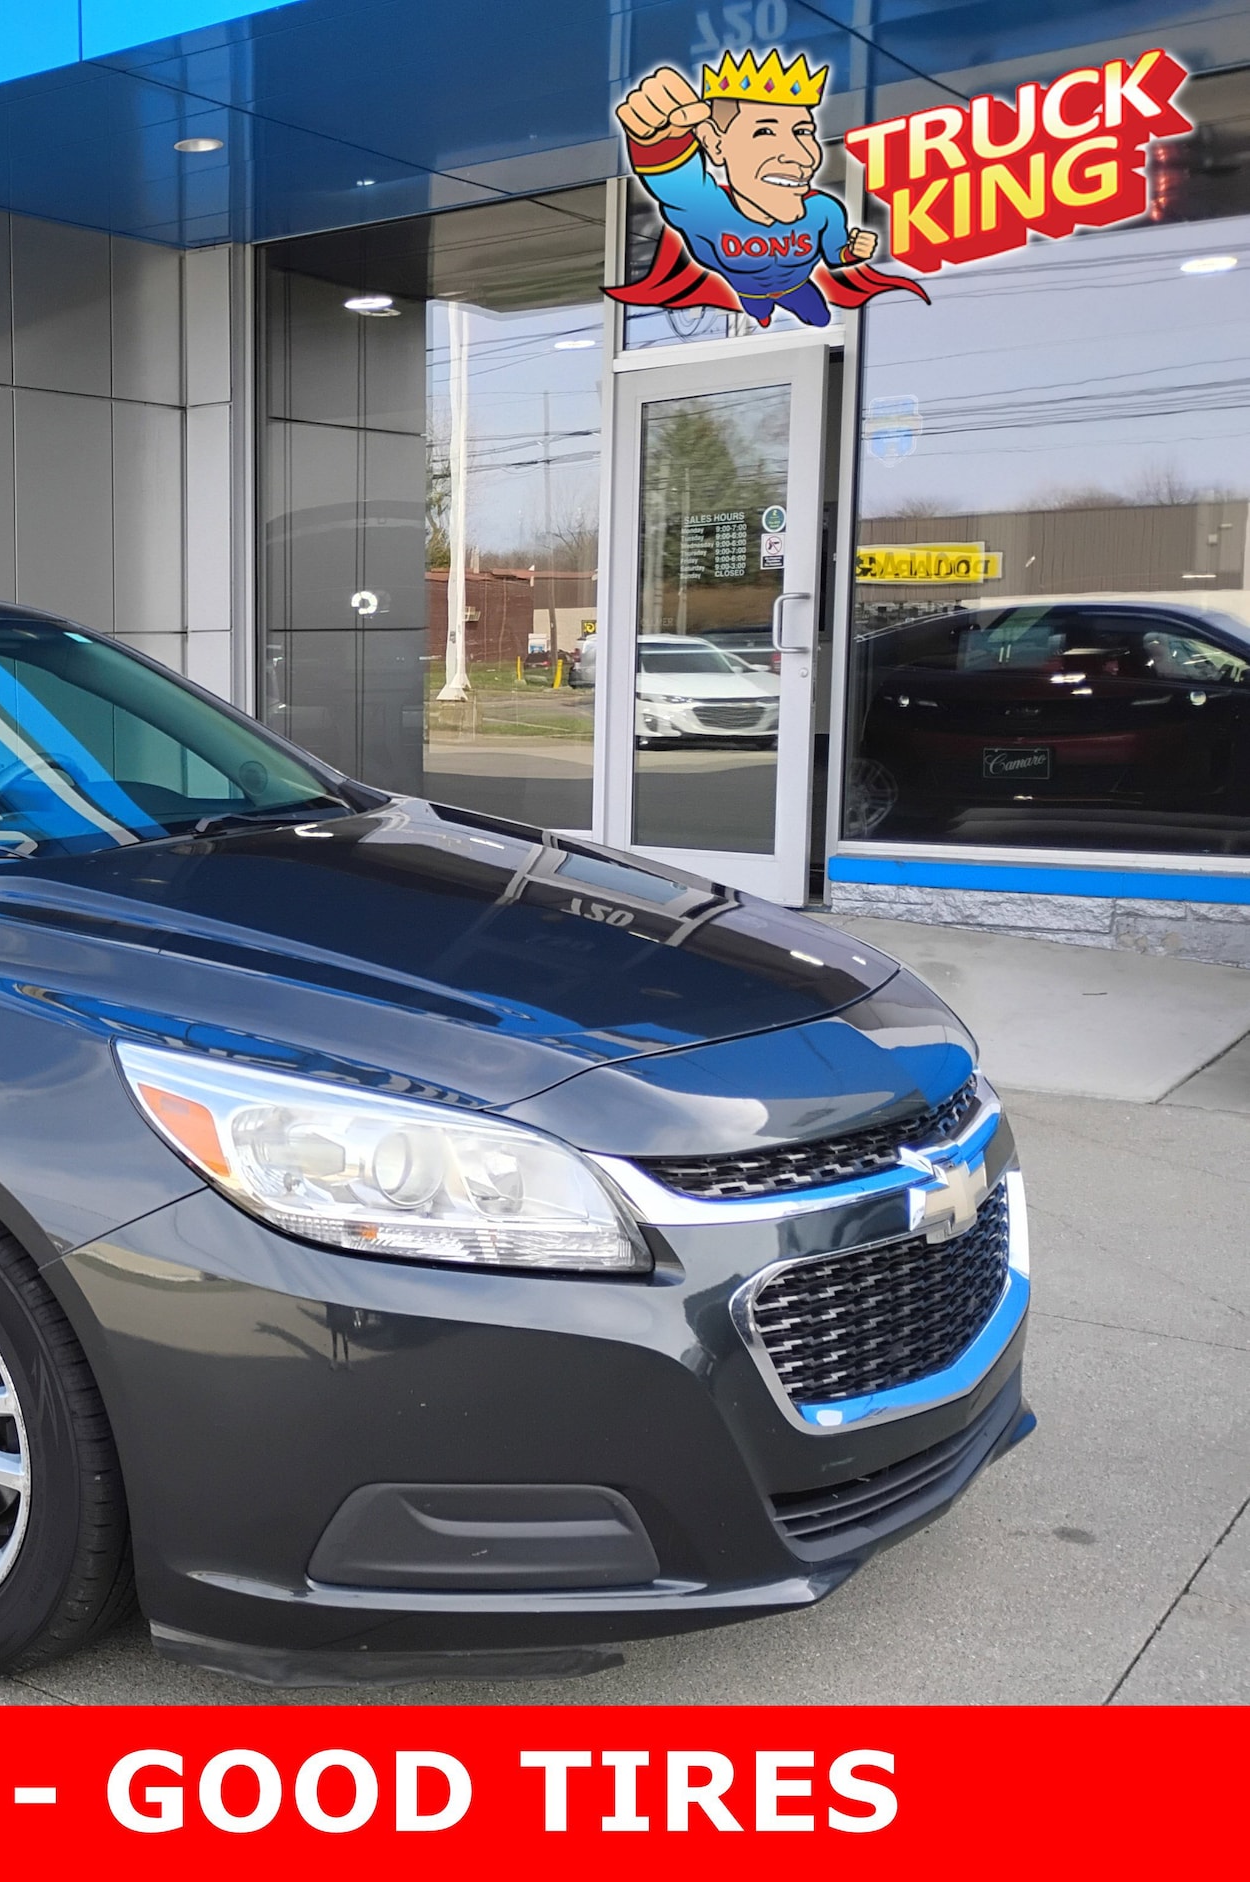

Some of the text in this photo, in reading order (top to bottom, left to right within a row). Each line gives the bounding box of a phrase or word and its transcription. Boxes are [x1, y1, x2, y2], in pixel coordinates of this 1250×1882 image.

[684, 512, 745, 525] SALES HOURS
[715, 524, 747, 532] 9:00-7:00
[714, 569, 745, 577] CLOSED
[985, 753, 1047, 775] Camaro
